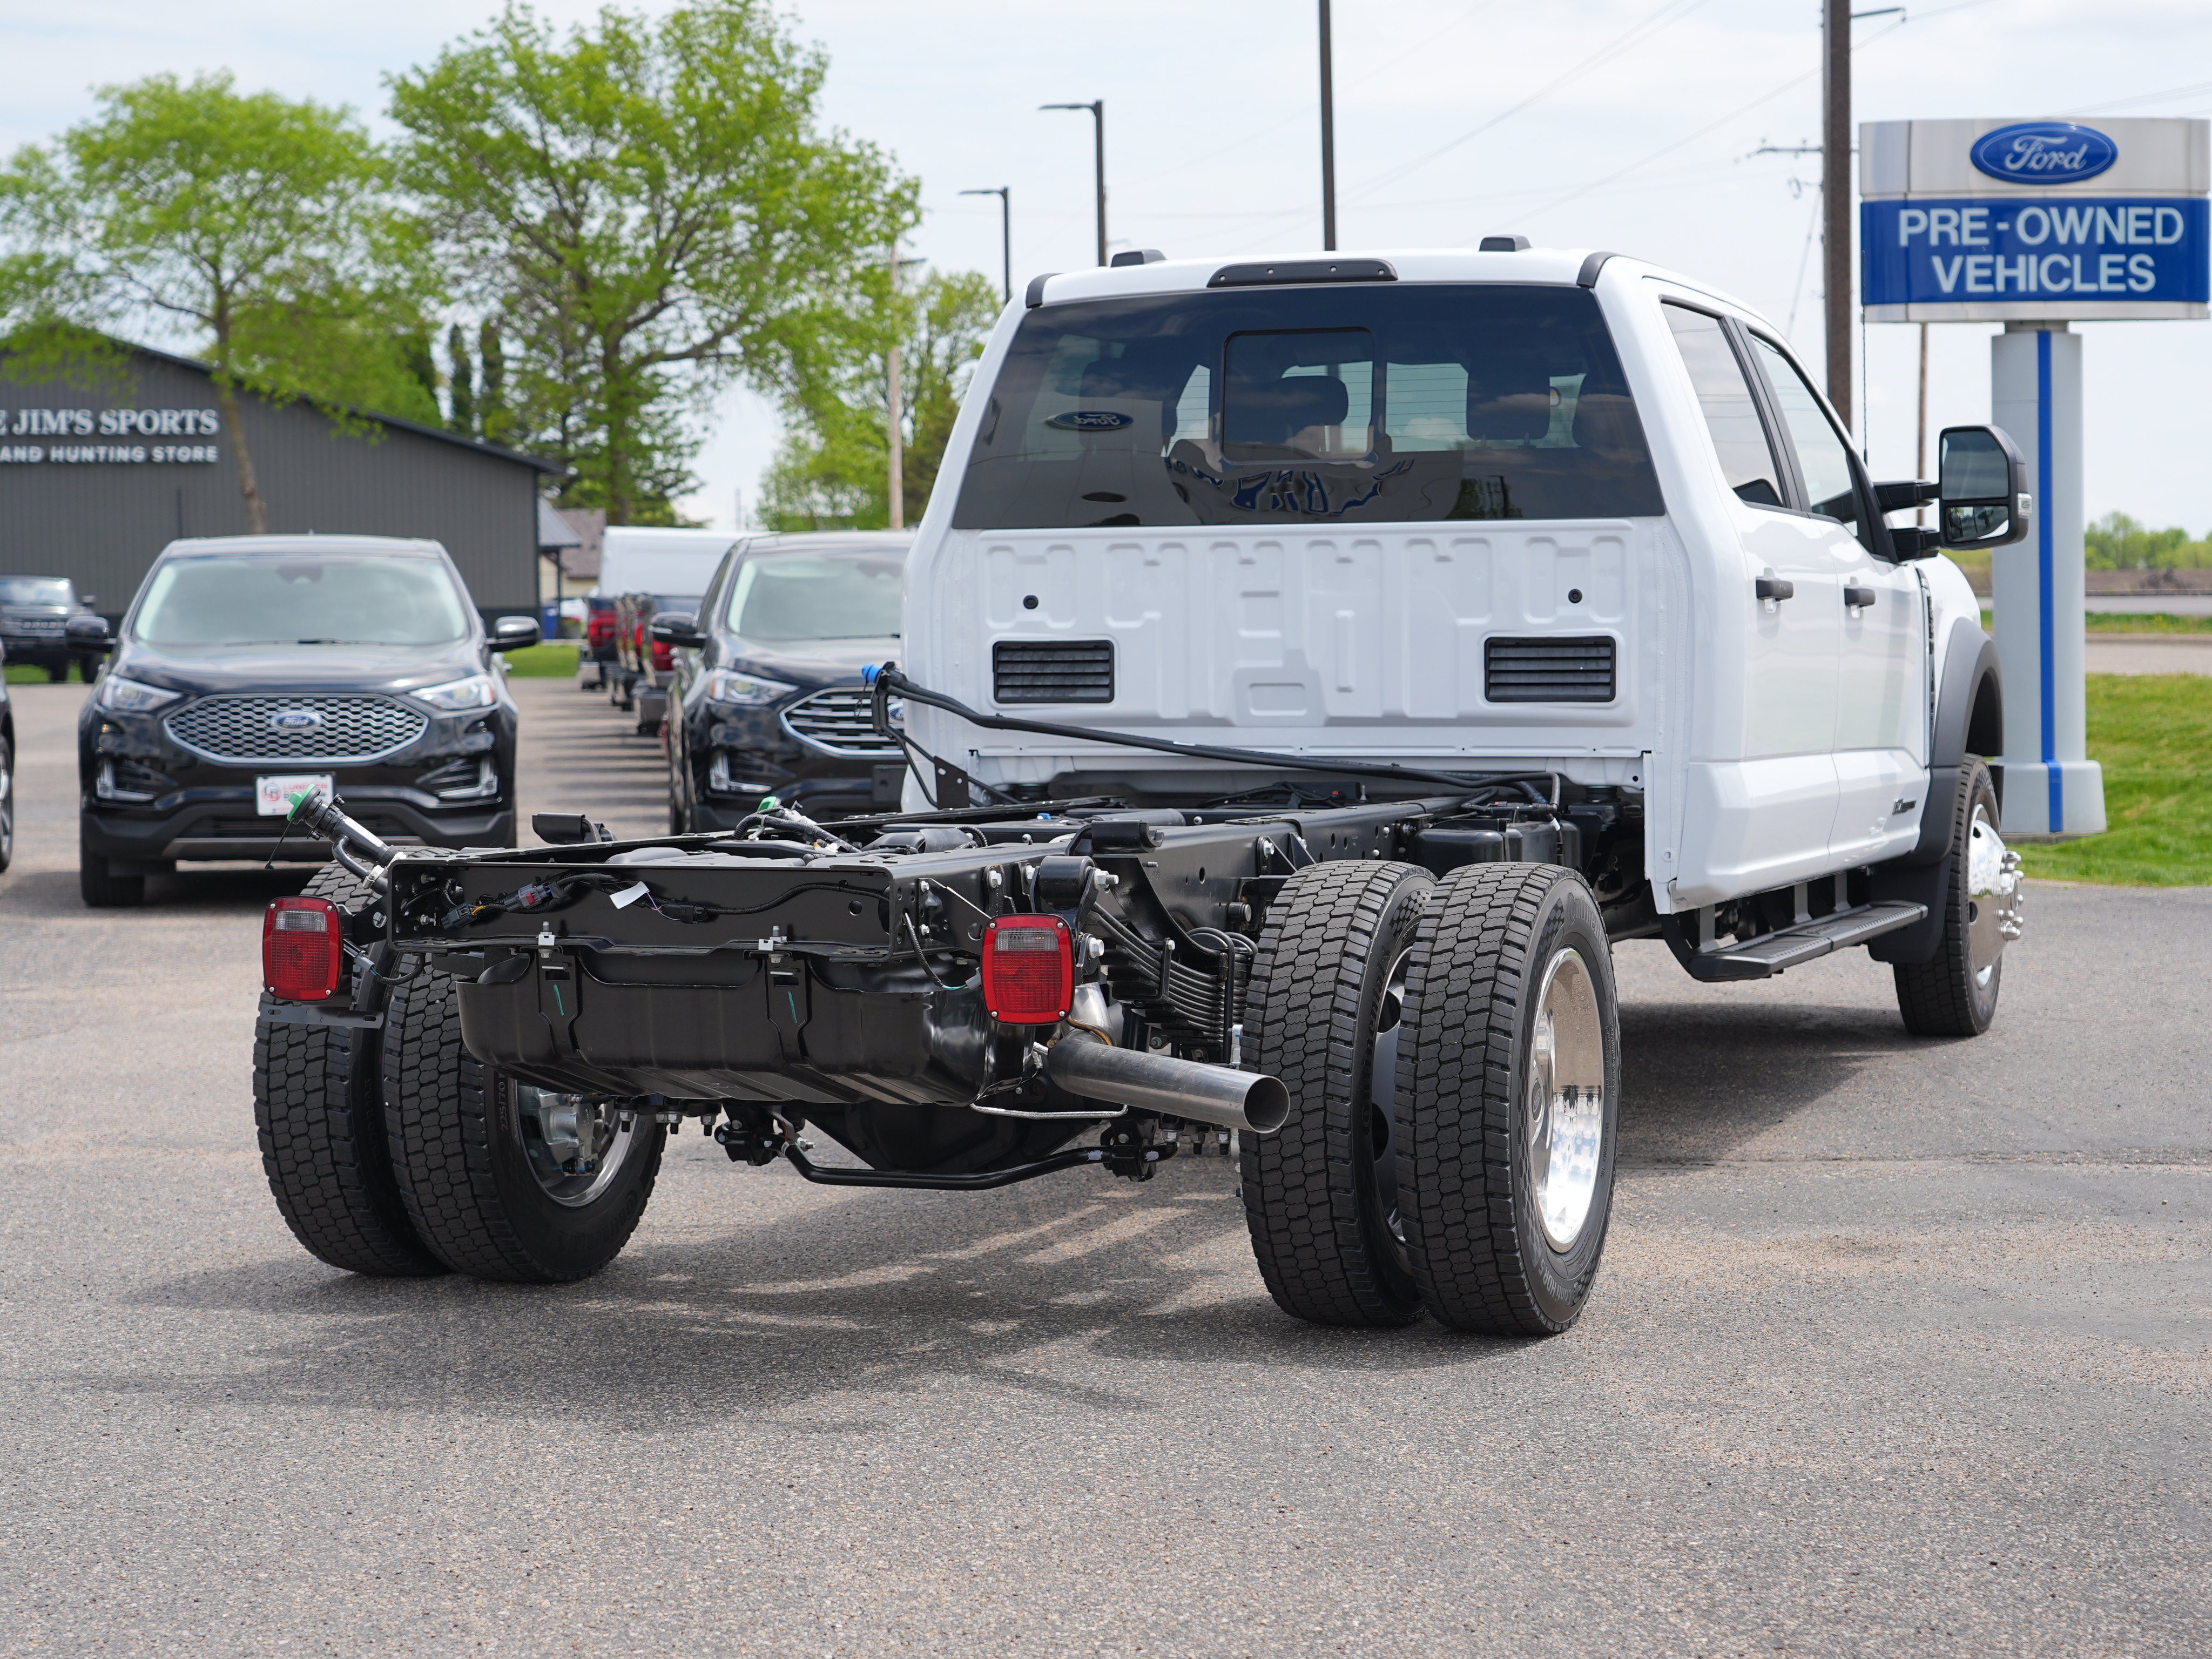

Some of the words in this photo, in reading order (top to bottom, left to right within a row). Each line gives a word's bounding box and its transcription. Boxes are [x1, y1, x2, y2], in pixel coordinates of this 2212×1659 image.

[2004, 134, 2088, 171] Ford
[1899, 206, 2184, 246] PRE-OWNED
[1931, 253, 2156, 293] VEHICLES
[12, 409, 95, 435] JIM'S
[99, 409, 220, 435] SPORTS
[0, 446, 44, 463] AND
[50, 446, 147, 463] HUNTING
[151, 446, 218, 463] STORE
